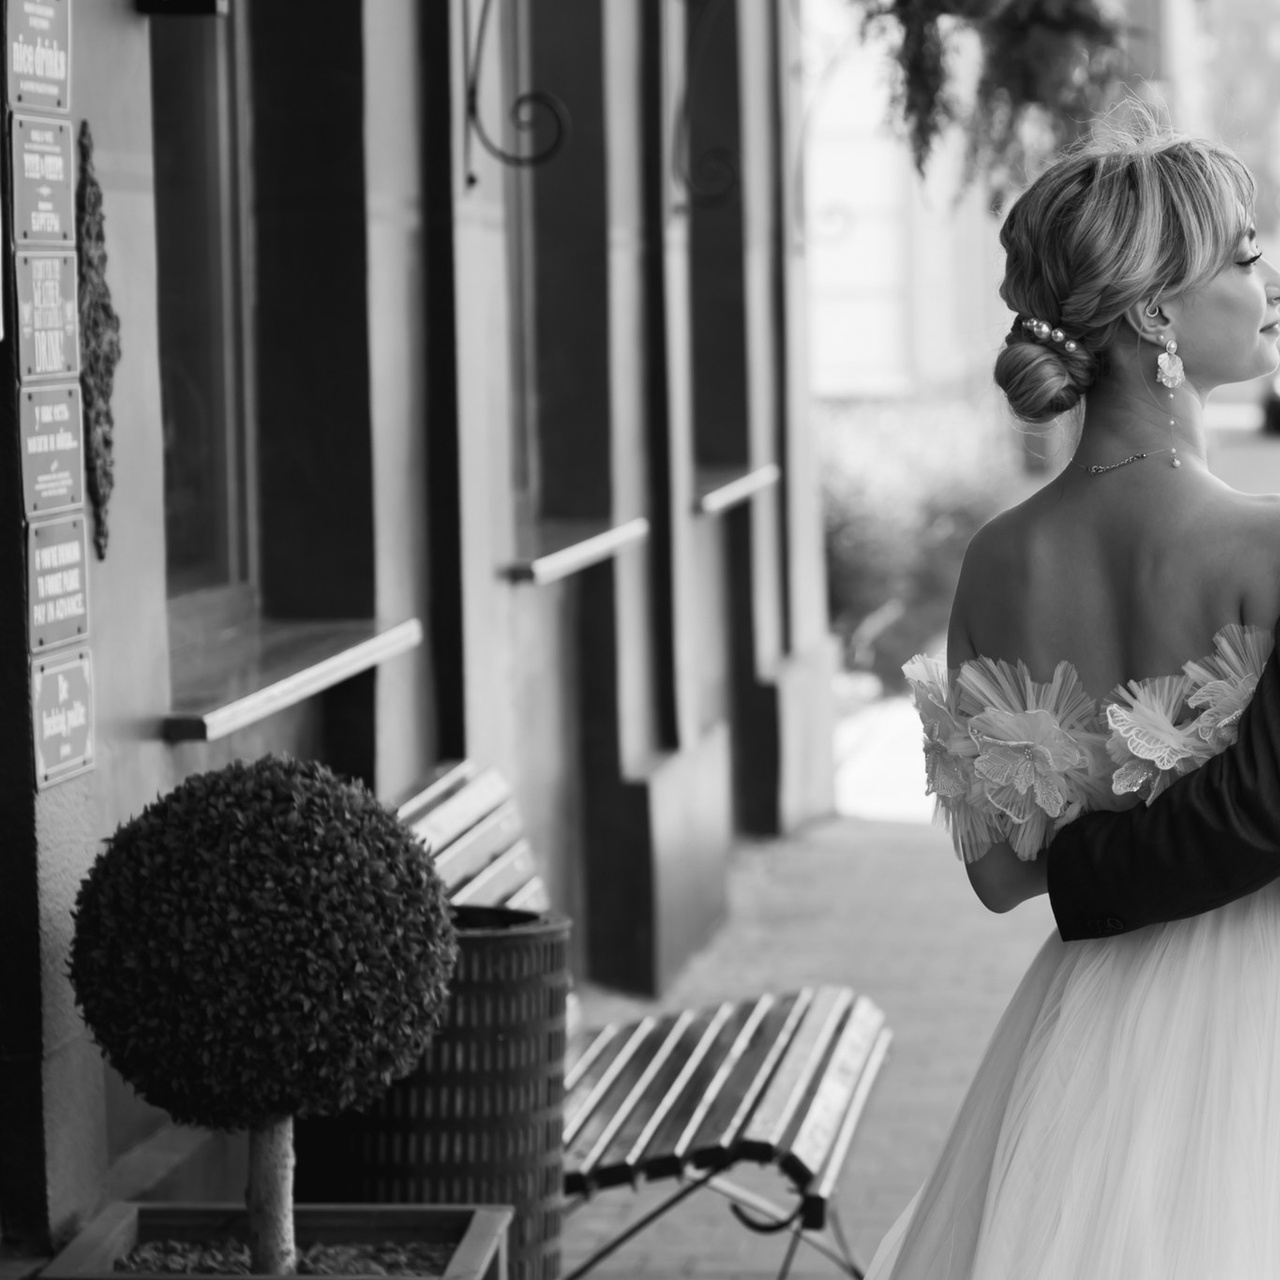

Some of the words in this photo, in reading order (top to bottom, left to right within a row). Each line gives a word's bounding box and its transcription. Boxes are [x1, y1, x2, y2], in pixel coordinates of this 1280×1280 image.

[12, 33, 34, 76] nice
[35, 36, 66, 80] drinks
[34, 602, 46, 627] PAY
[46, 600, 55, 623] IN
